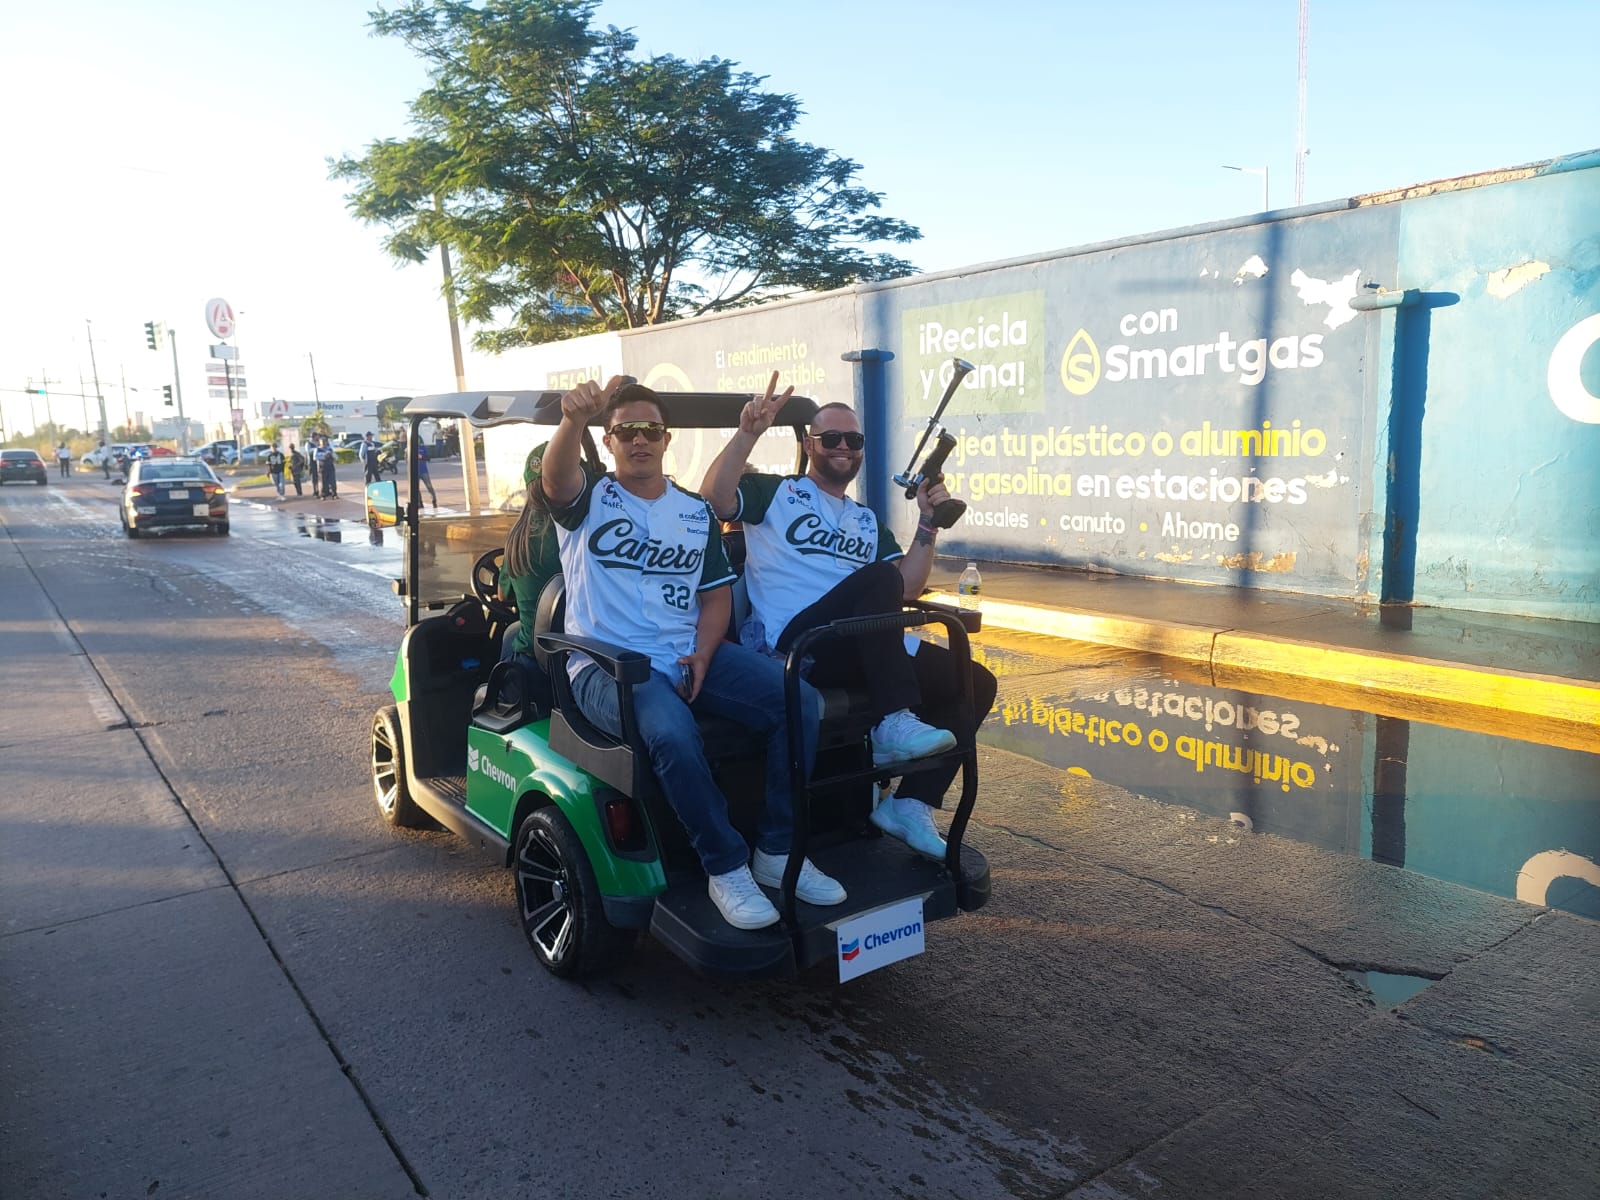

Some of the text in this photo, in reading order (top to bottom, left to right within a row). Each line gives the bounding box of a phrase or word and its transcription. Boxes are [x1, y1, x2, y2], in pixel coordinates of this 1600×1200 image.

[1119, 308, 1178, 337] con
[715, 338, 808, 369] El rendimiento
[1104, 331, 1325, 386] Smartgas
[920, 368, 935, 400] y
[1001, 427, 1027, 456] tu
[1031, 425, 1146, 465] plástico
[1151, 431, 1174, 456] o
[1180, 420, 1327, 457] aluminio
[969, 466, 1072, 501] gasolina
[1076, 473, 1110, 498] en
[1115, 467, 1308, 505] estaciones
[965, 506, 1240, 542] Rosales canuto Ahome
[661, 583, 691, 610] 22
[481, 754, 517, 793] Chevron
[864, 919, 922, 952] Chevron
